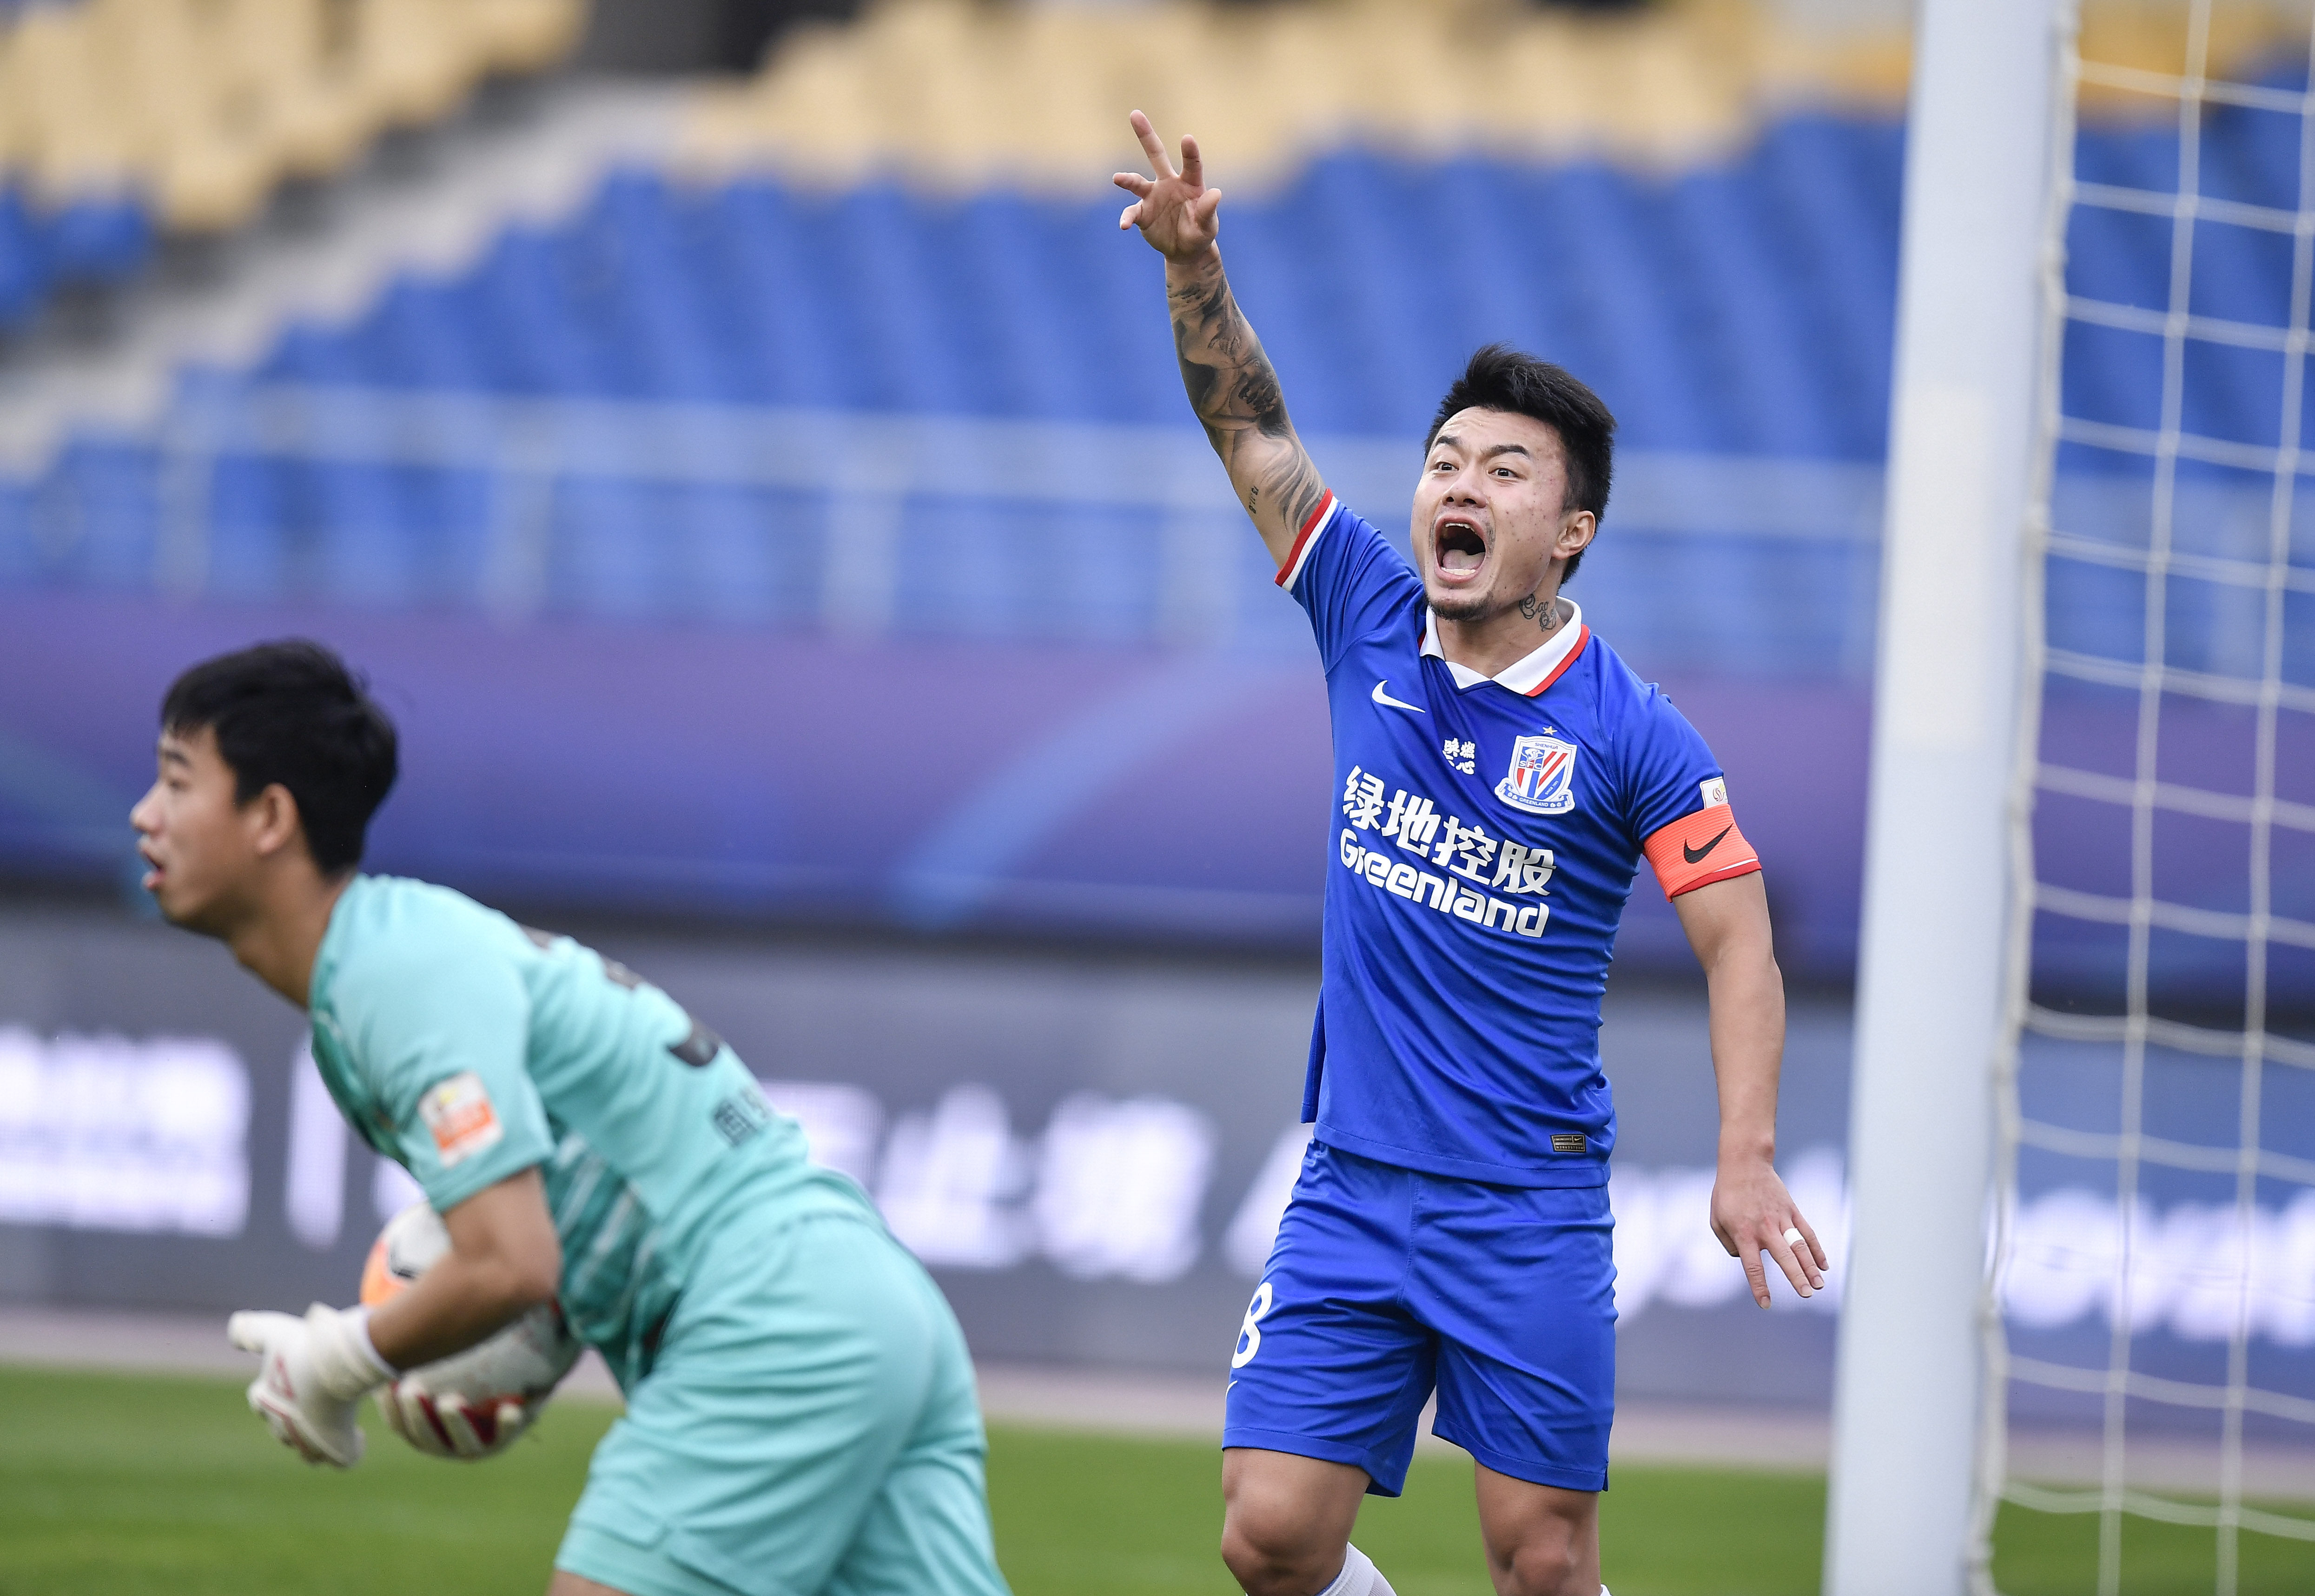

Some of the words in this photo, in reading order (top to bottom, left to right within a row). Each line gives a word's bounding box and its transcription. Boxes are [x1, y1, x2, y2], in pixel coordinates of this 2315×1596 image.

[1519, 760, 1542, 770] SFC
[1519, 797, 1548, 807] GREENLAND
[1343, 765, 1557, 897] 绿地控股
[1340, 828, 1550, 939] Greenland
[1231, 1282, 1273, 1369] 8
